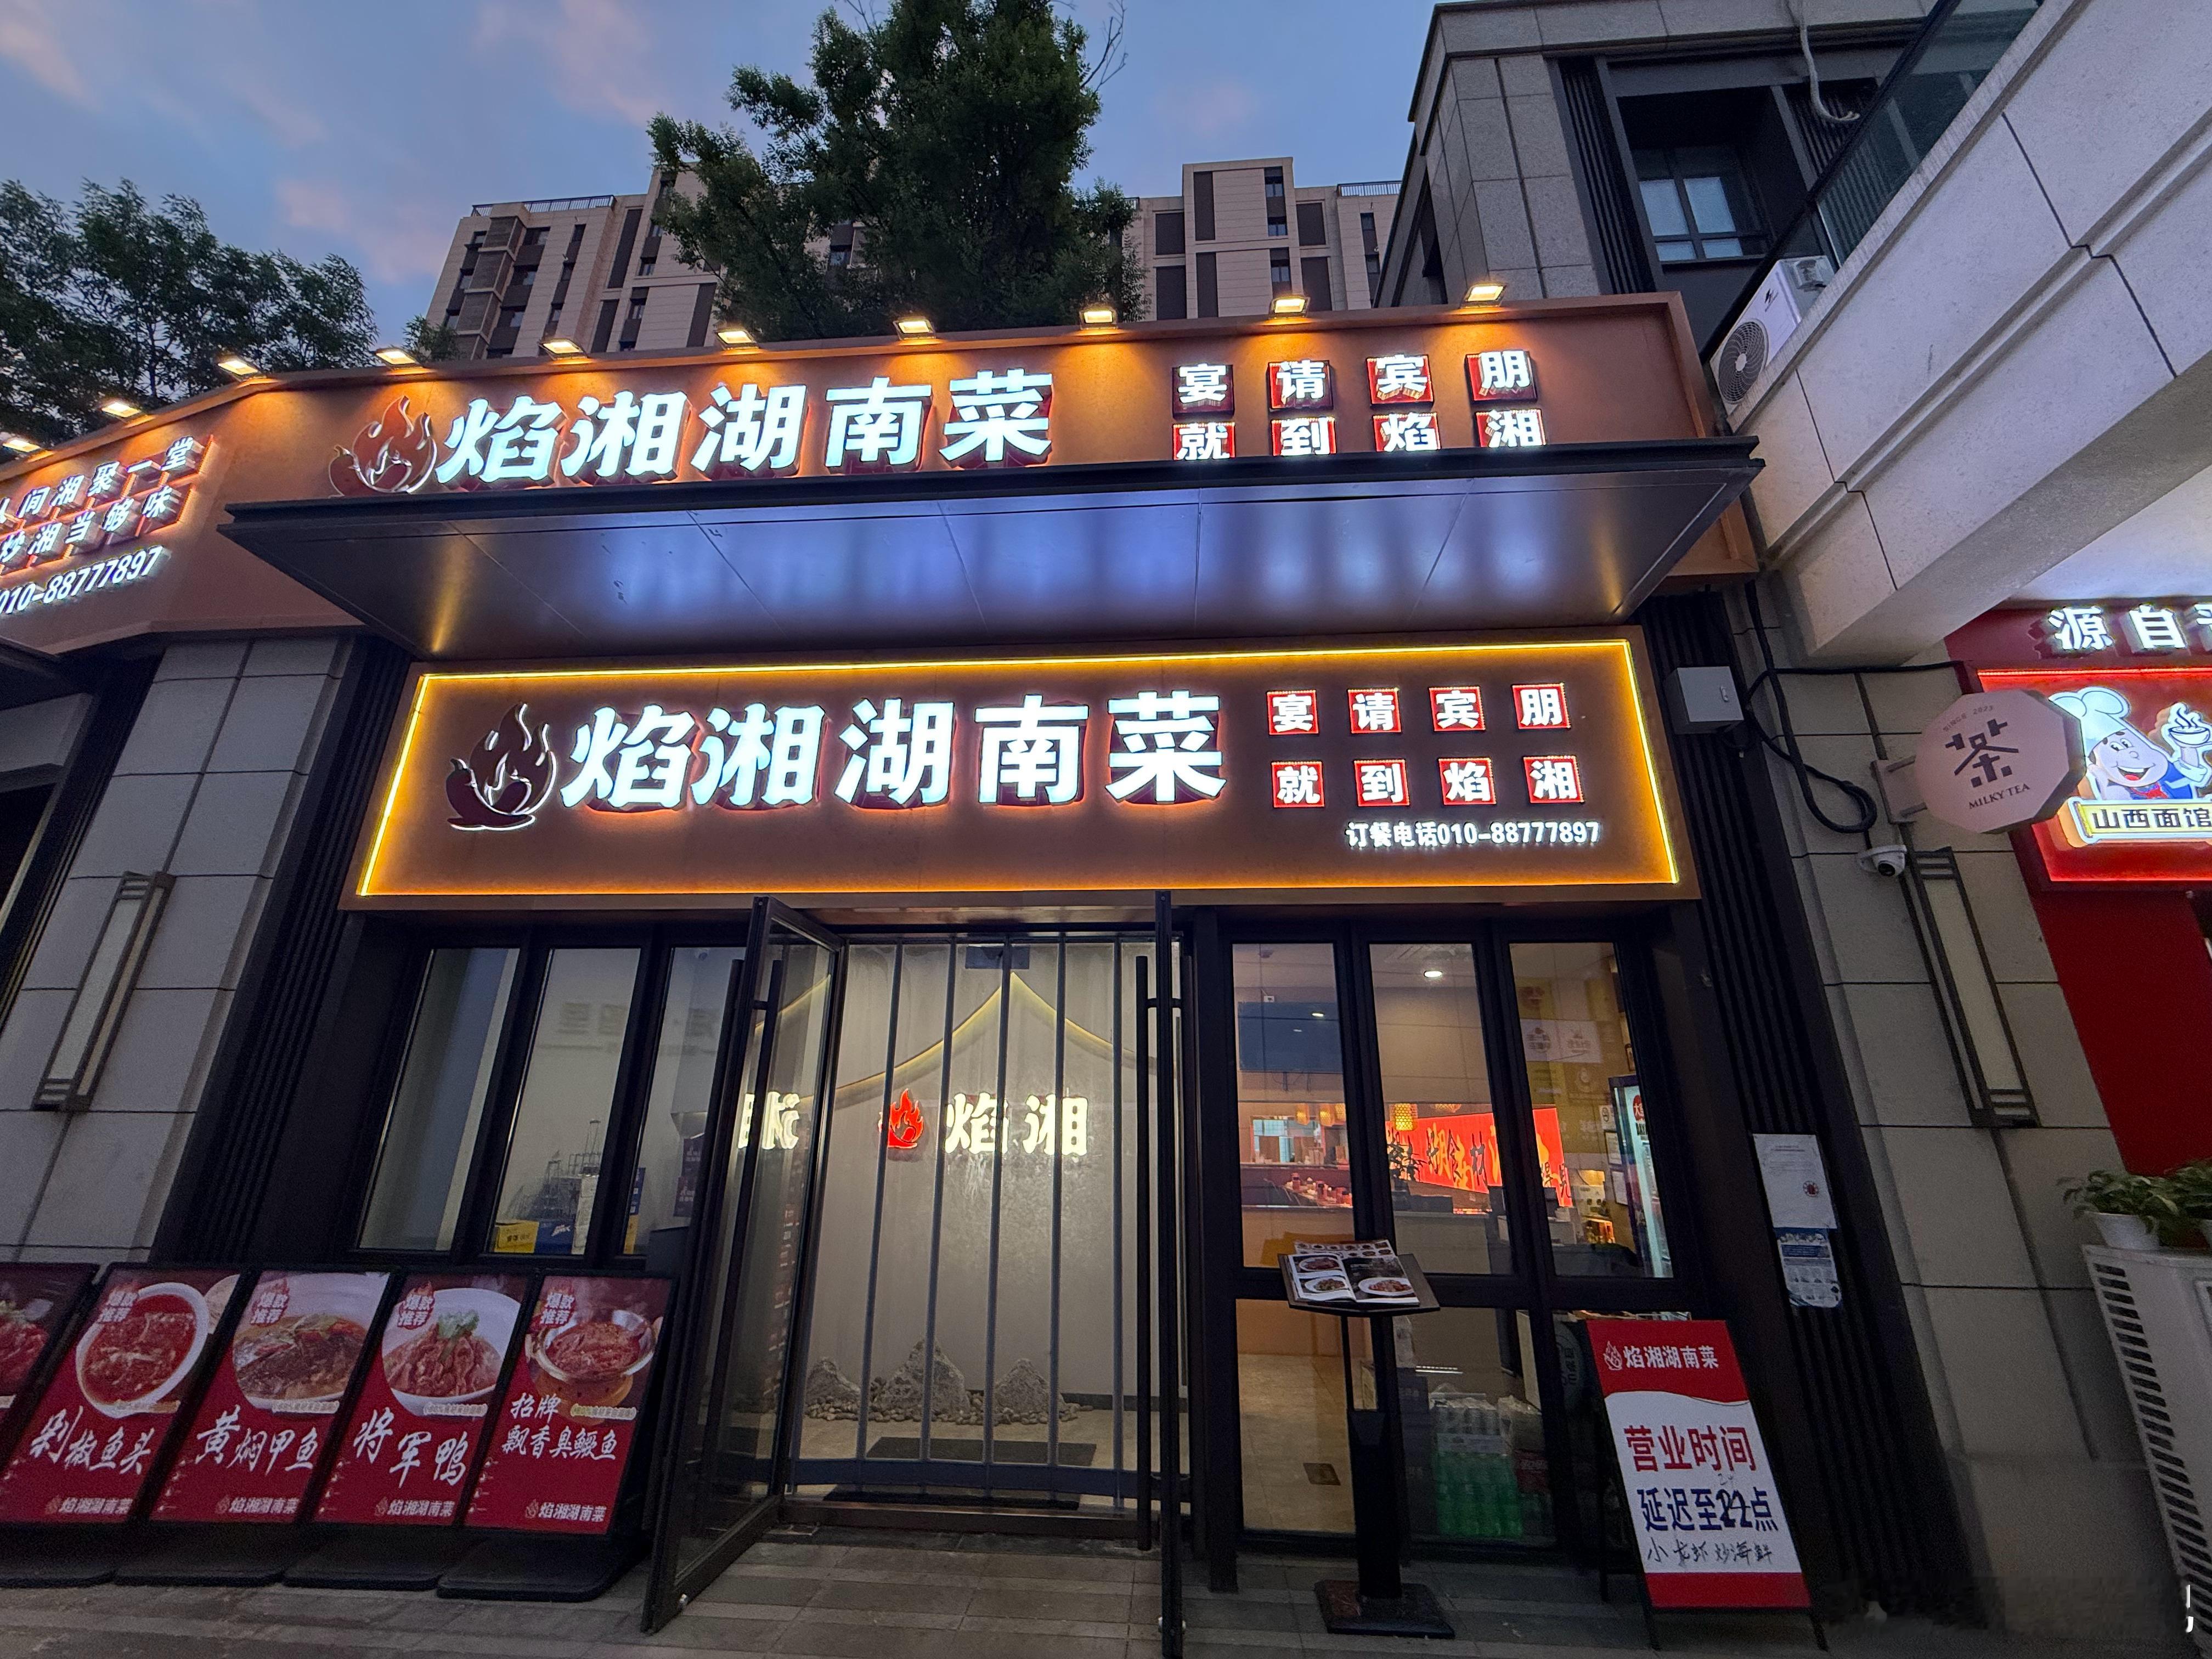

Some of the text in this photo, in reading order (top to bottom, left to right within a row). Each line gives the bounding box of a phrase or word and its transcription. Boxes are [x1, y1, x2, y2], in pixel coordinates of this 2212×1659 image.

[1178, 349, 1531, 404] 宴请宾朋
[435, 368, 1053, 483] 焰湘湖南菜
[1176, 409, 1541, 461] 就到焰湘
[1272, 688, 1563, 733] 宴请宾朋
[560, 690, 1227, 808] 焰湘湖南菜
[1276, 760, 1579, 804] 就到焰湘
[1969, 783, 2030, 809] MILKY TEA
[1345, 821, 1599, 848] 订餐电话010-88777897
[2092, 807, 2212, 830] 山西面馆
[945, 1092, 1088, 1155] 焰湘
[397, 1310, 430, 1327] 推荐
[404, 1294, 435, 1311] 爆款
[540, 1309, 572, 1325] 推荐
[546, 1293, 575, 1310] 爆款
[1623, 1346, 1719, 1369] 焰湘湖南菜
[510, 1393, 561, 1421] 招牌
[30, 1405, 155, 1475] 剁椒鱼头
[195, 1404, 318, 1475] 黄焖甲鱼
[353, 1407, 468, 1488] 将军鸭
[1624, 1425, 1757, 1472] 营业时间
[388, 1499, 456, 1517] 焰湘湖南菜
[539, 1502, 607, 1522] 焰湘湖南菜
